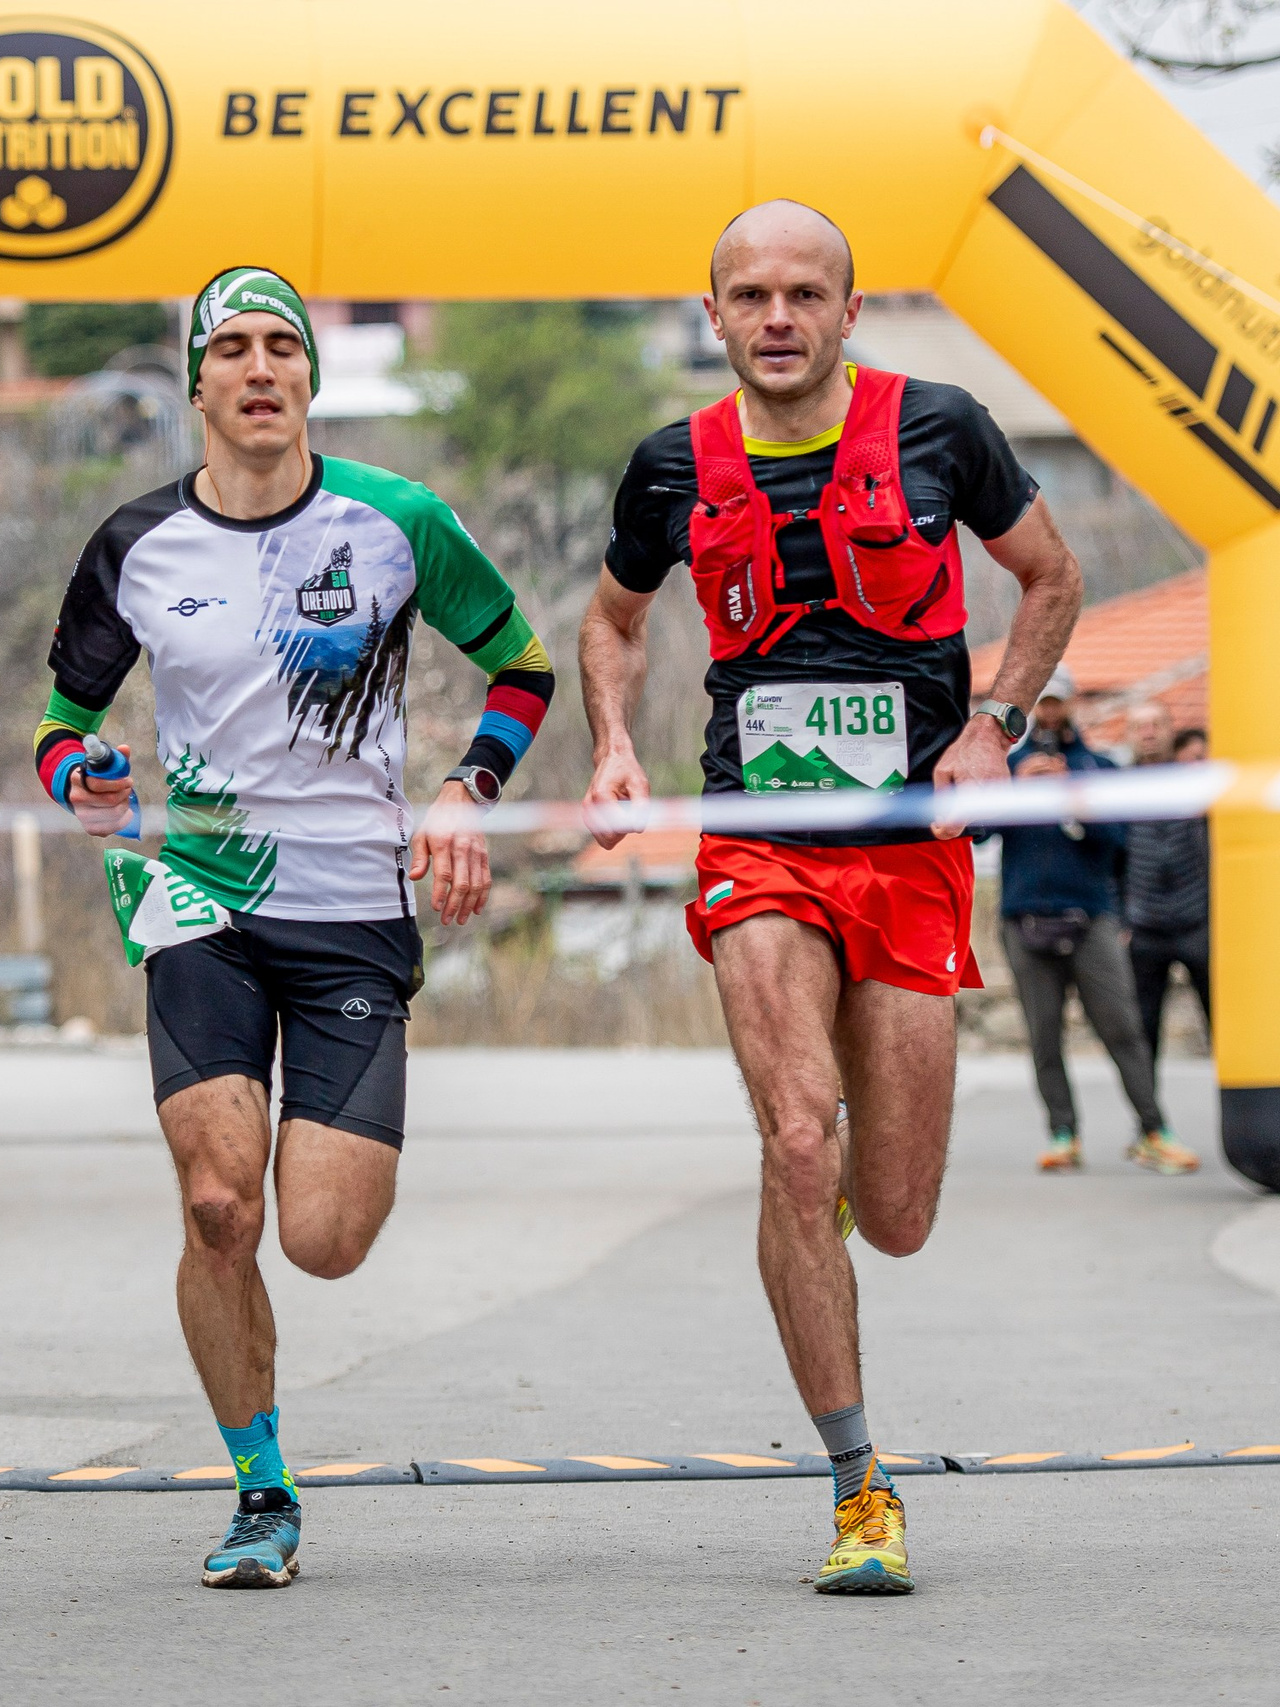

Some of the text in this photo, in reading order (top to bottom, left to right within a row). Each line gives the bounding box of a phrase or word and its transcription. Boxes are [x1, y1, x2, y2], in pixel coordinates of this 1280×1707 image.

[220, 88, 743, 138] BE EXCELLENT
[331, 571, 348, 588] 50
[301, 589, 352, 612] OREHOVO
[728, 584, 743, 622] SILVA
[745, 719, 765, 731] 44K
[806, 695, 896, 736] 4138
